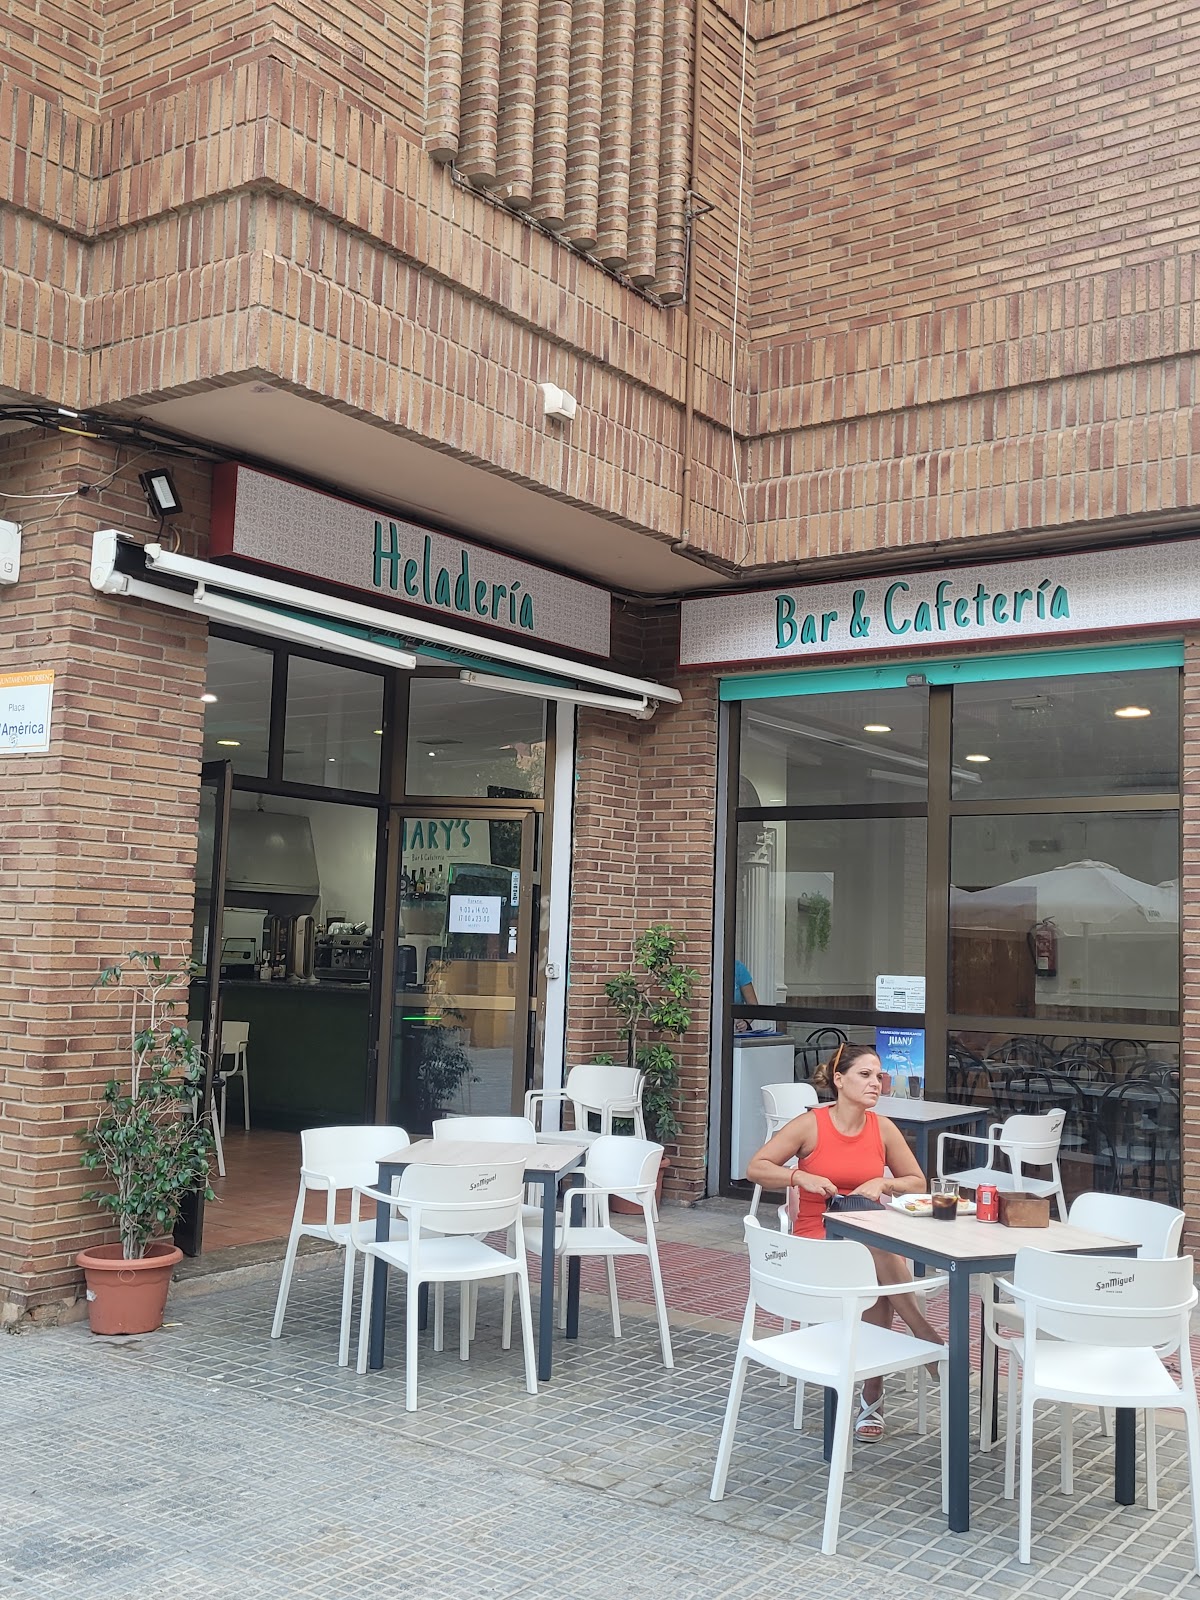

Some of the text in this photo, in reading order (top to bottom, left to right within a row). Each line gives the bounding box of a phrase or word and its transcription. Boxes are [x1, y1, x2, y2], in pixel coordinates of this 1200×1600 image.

[373, 521, 534, 630] Heladería
[776, 579, 1070, 648] Bar & Cafetería
[8, 703, 25, 712] Plaça
[950, 1261, 956, 1272] 3
